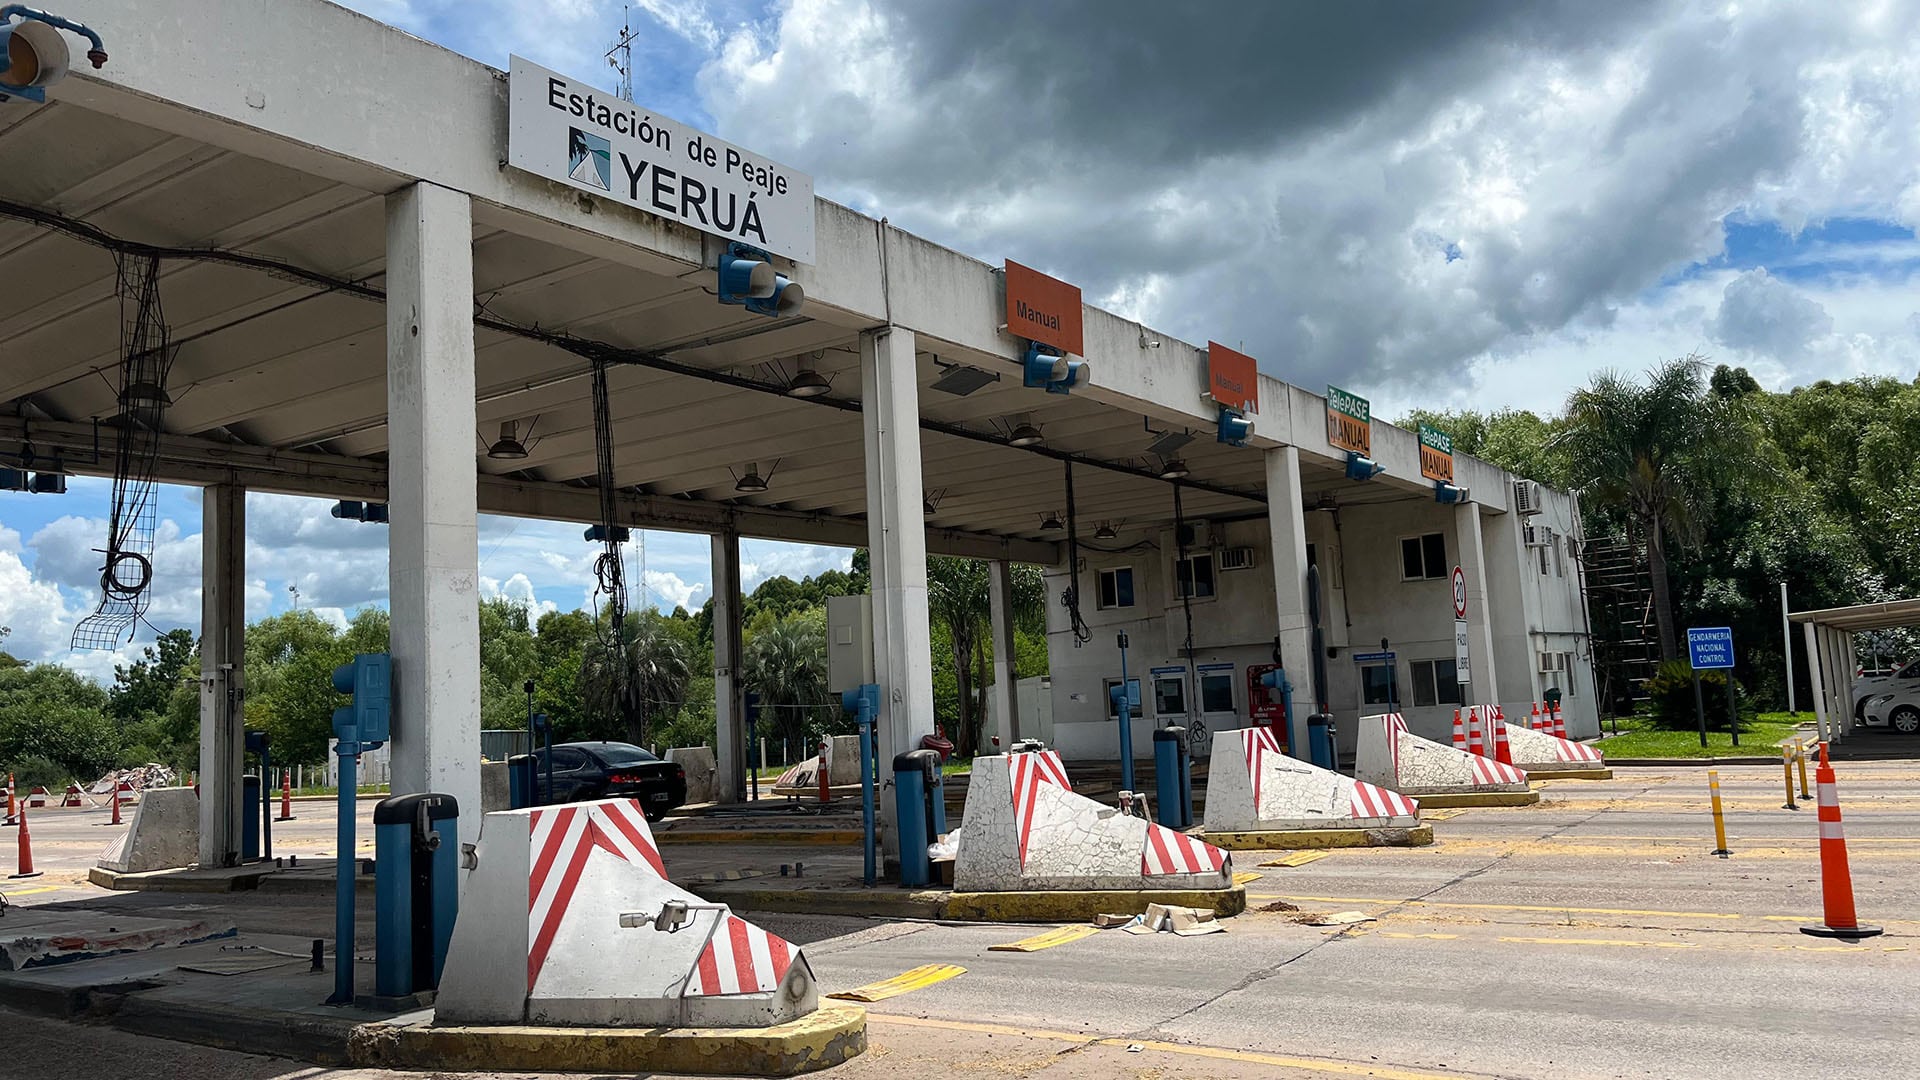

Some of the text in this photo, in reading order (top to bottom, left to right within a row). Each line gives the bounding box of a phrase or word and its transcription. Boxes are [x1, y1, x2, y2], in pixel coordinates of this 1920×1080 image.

[548, 77, 787, 197] Estación de Peaje
[618, 152, 767, 244] YERUÁ
[1016, 299, 1060, 331] Manual
[1215, 370, 1243, 394] Manual
[1329, 388, 1369, 420] TelePASE
[1329, 413, 1369, 451] MANUAL
[1421, 426, 1450, 453] TelePASE
[1422, 449, 1452, 480] MANUAL
[1455, 581, 1464, 603] 20
[1457, 633, 1467, 646] PASO
[1696, 643, 1726, 653] NACIONAL
[1458, 657, 1469, 670] LIBRE
[1698, 654, 1726, 664] CONTROL
